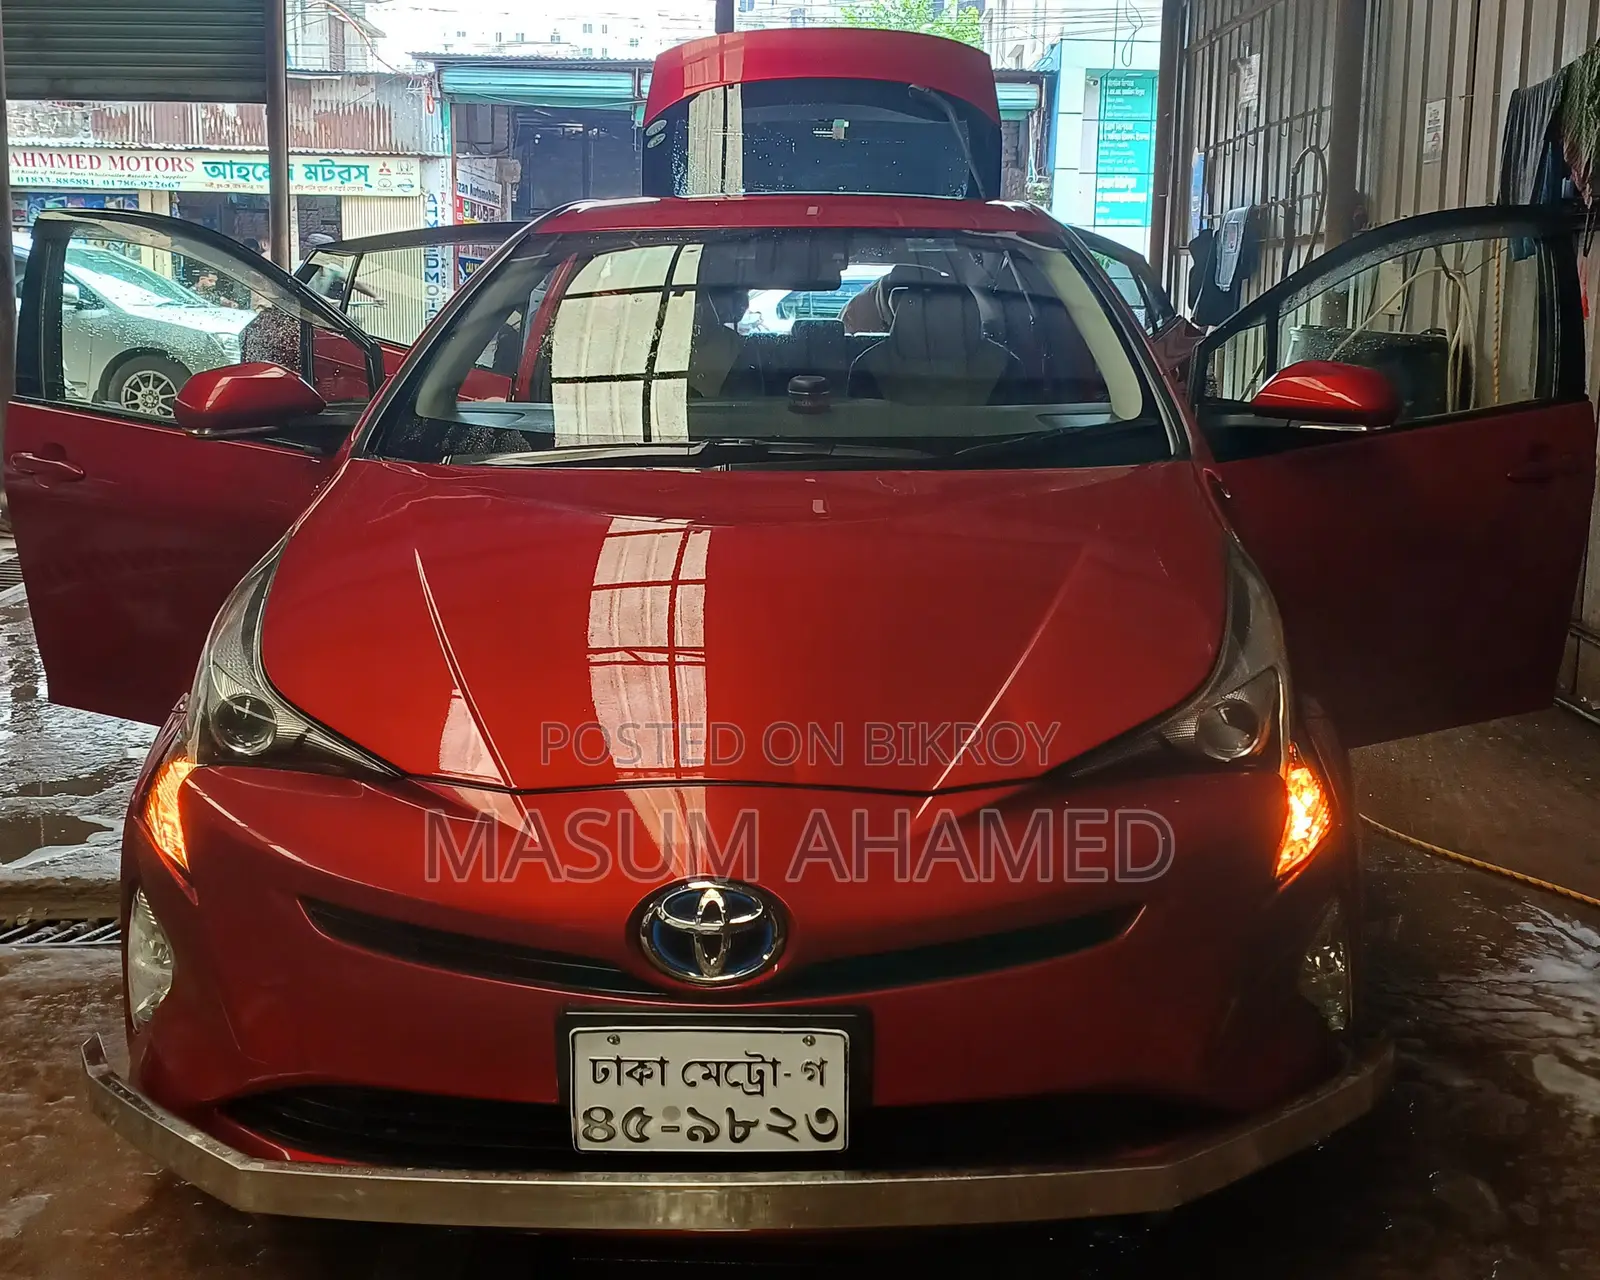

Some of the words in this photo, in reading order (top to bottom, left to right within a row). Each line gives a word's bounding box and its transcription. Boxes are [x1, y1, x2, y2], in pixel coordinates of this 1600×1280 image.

[9, 151, 102, 170] AHMMED
[108, 154, 195, 173] MOTORS
[588, 1055, 670, 1087] ঢাকা
[581, 1105, 840, 1144] ৪৫-৯৮২৩
